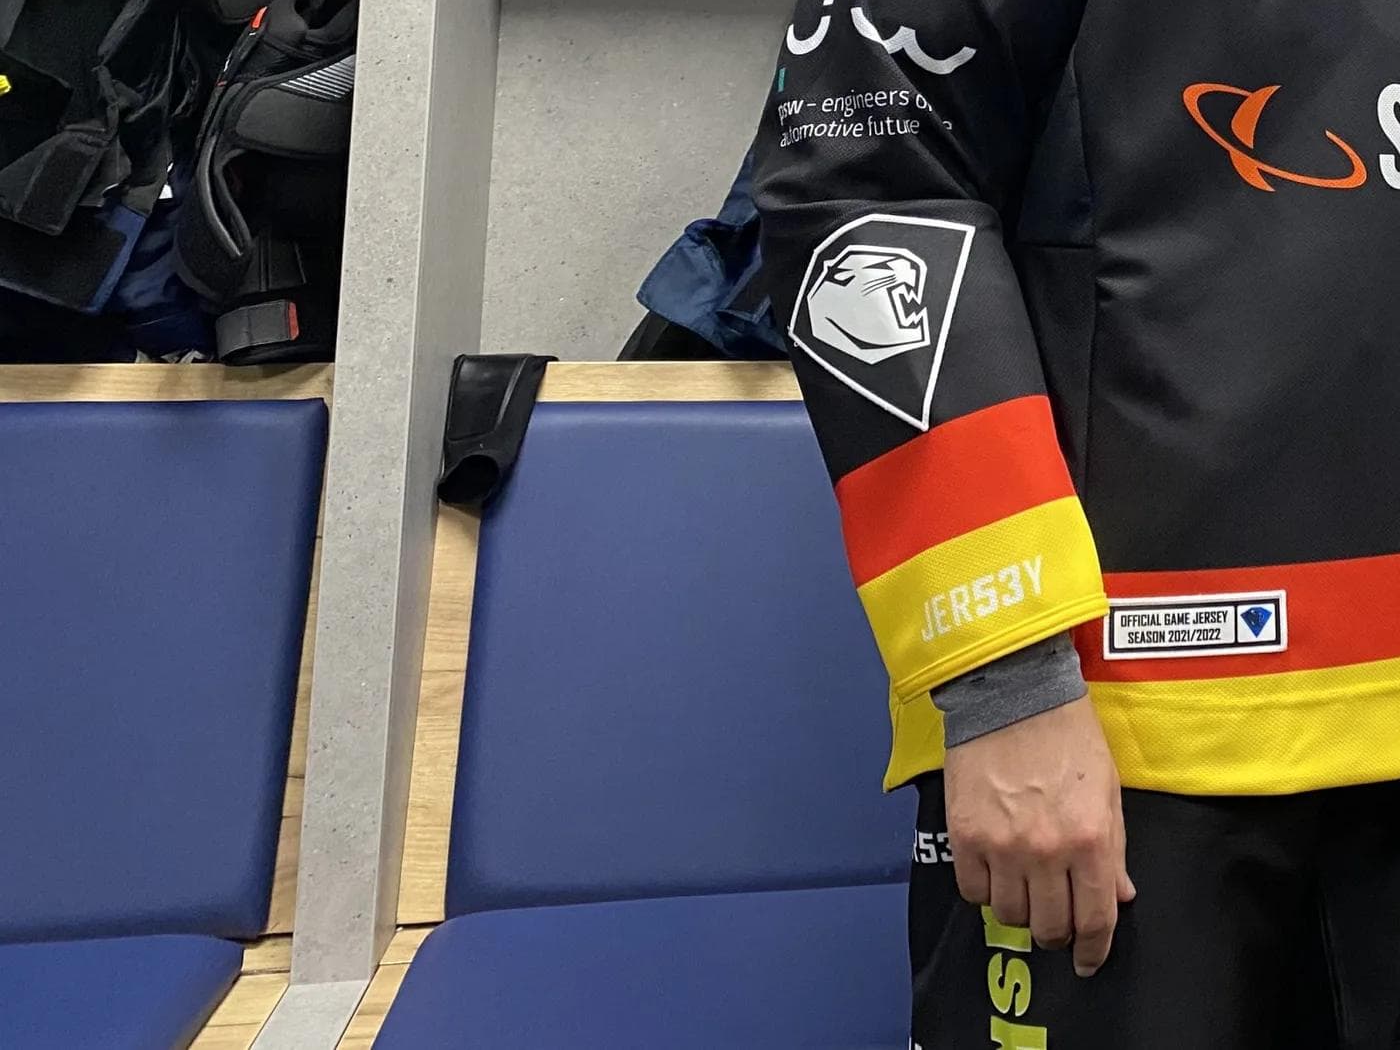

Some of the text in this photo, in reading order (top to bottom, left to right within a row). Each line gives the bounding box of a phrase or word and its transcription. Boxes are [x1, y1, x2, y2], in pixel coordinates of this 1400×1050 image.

[821, 89, 910, 117] engineers
[780, 115, 920, 148] automotive future
[921, 554, 1042, 643] JER53Y
[1120, 610, 1229, 628] OFFICIAL GAME JERSEY
[1127, 628, 1222, 644] SEASON 2021/2022
